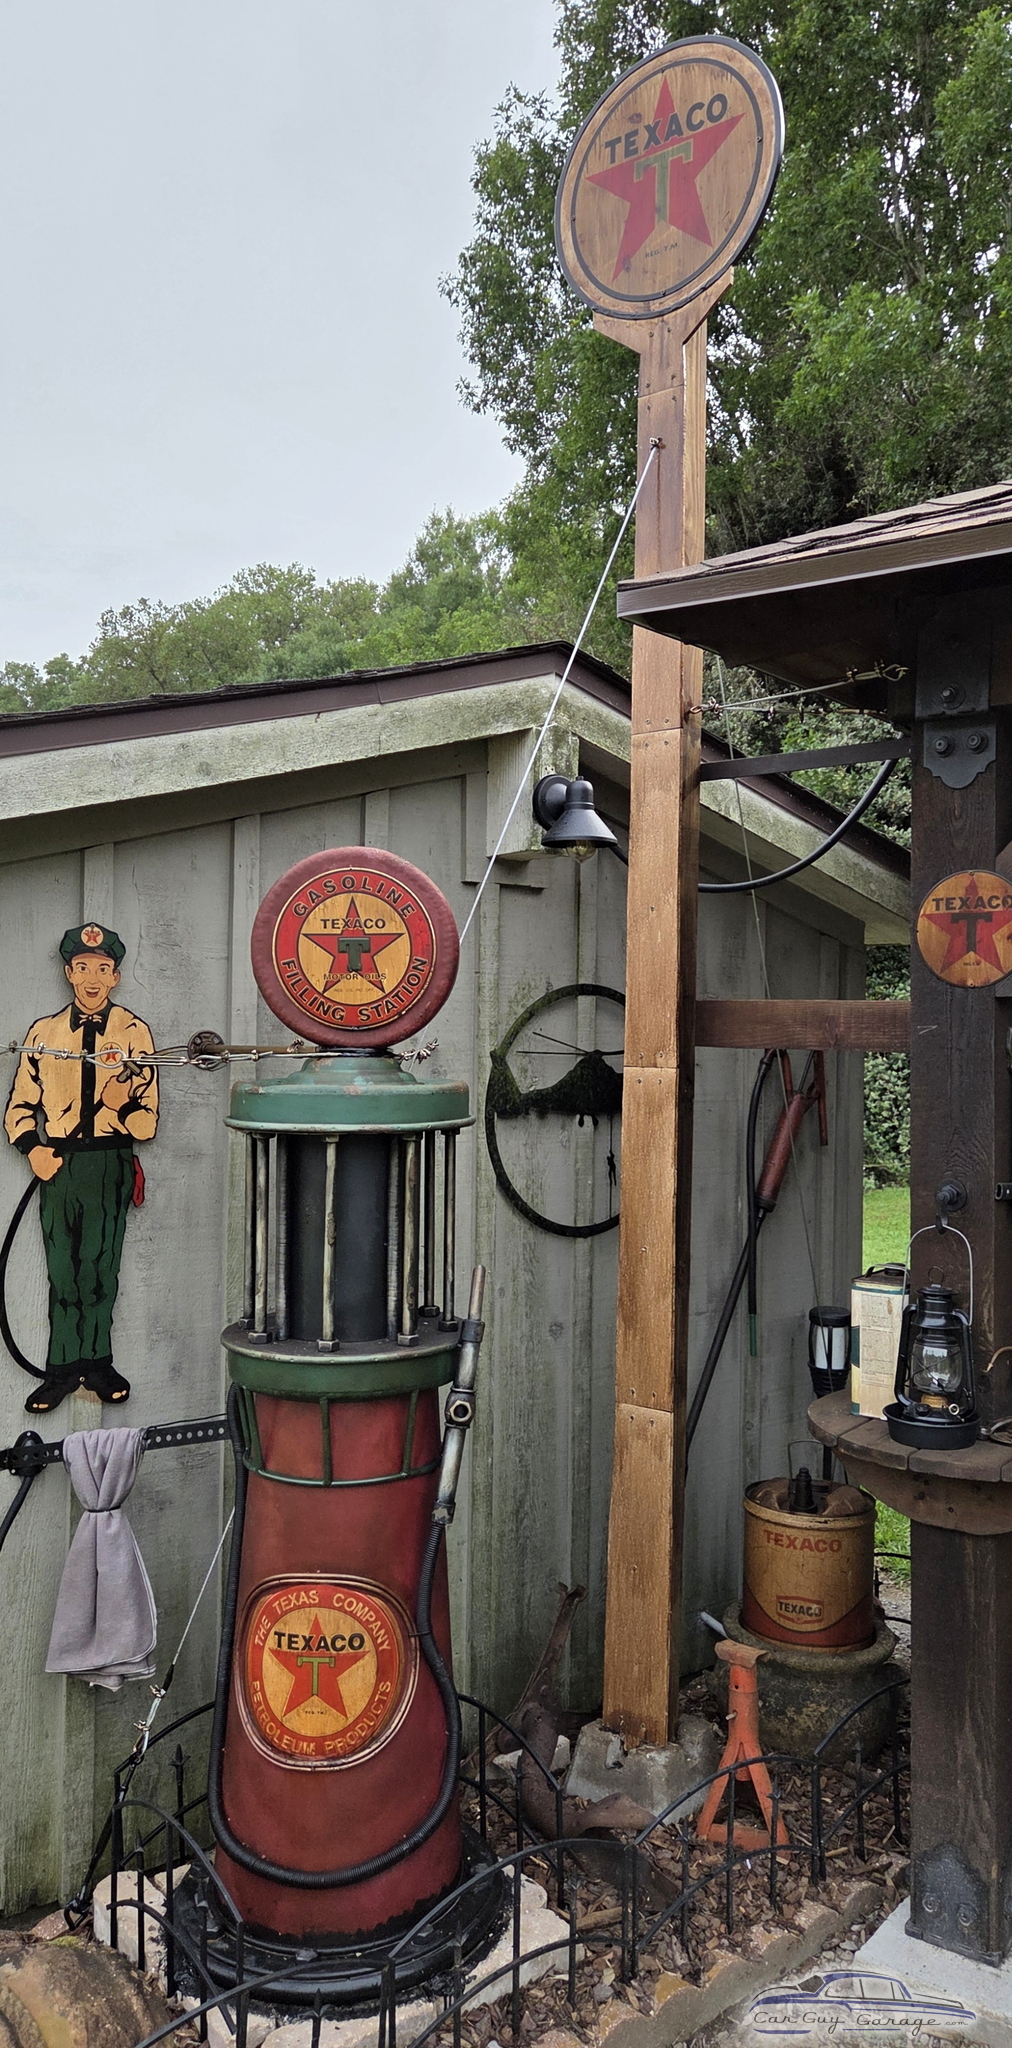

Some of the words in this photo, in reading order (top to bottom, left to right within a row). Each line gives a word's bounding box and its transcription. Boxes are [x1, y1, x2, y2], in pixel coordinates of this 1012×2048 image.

[605, 94, 728, 164] TEXACO
[634, 140, 693, 225] T
[293, 875, 416, 918] GASOLINE
[320, 918, 386, 929] TEXACO
[282, 958, 345, 1021] FILLING
[358, 957, 428, 1022] STATION
[323, 973, 359, 981] MOTOR
[365, 973, 387, 981] OILS
[763, 1530, 842, 1553] TEXACO
[254, 1615, 272, 1648] THE
[272, 1590, 320, 1615] TEXAS
[332, 1592, 391, 1651] COMPANY
[778, 1601, 823, 1618] TEXACO
[274, 1631, 365, 1651] TEXACO
[297, 1656, 335, 1696] T
[251, 1680, 316, 1755] PETROLEUM
[324, 1681, 392, 1754] PRODUCTS
